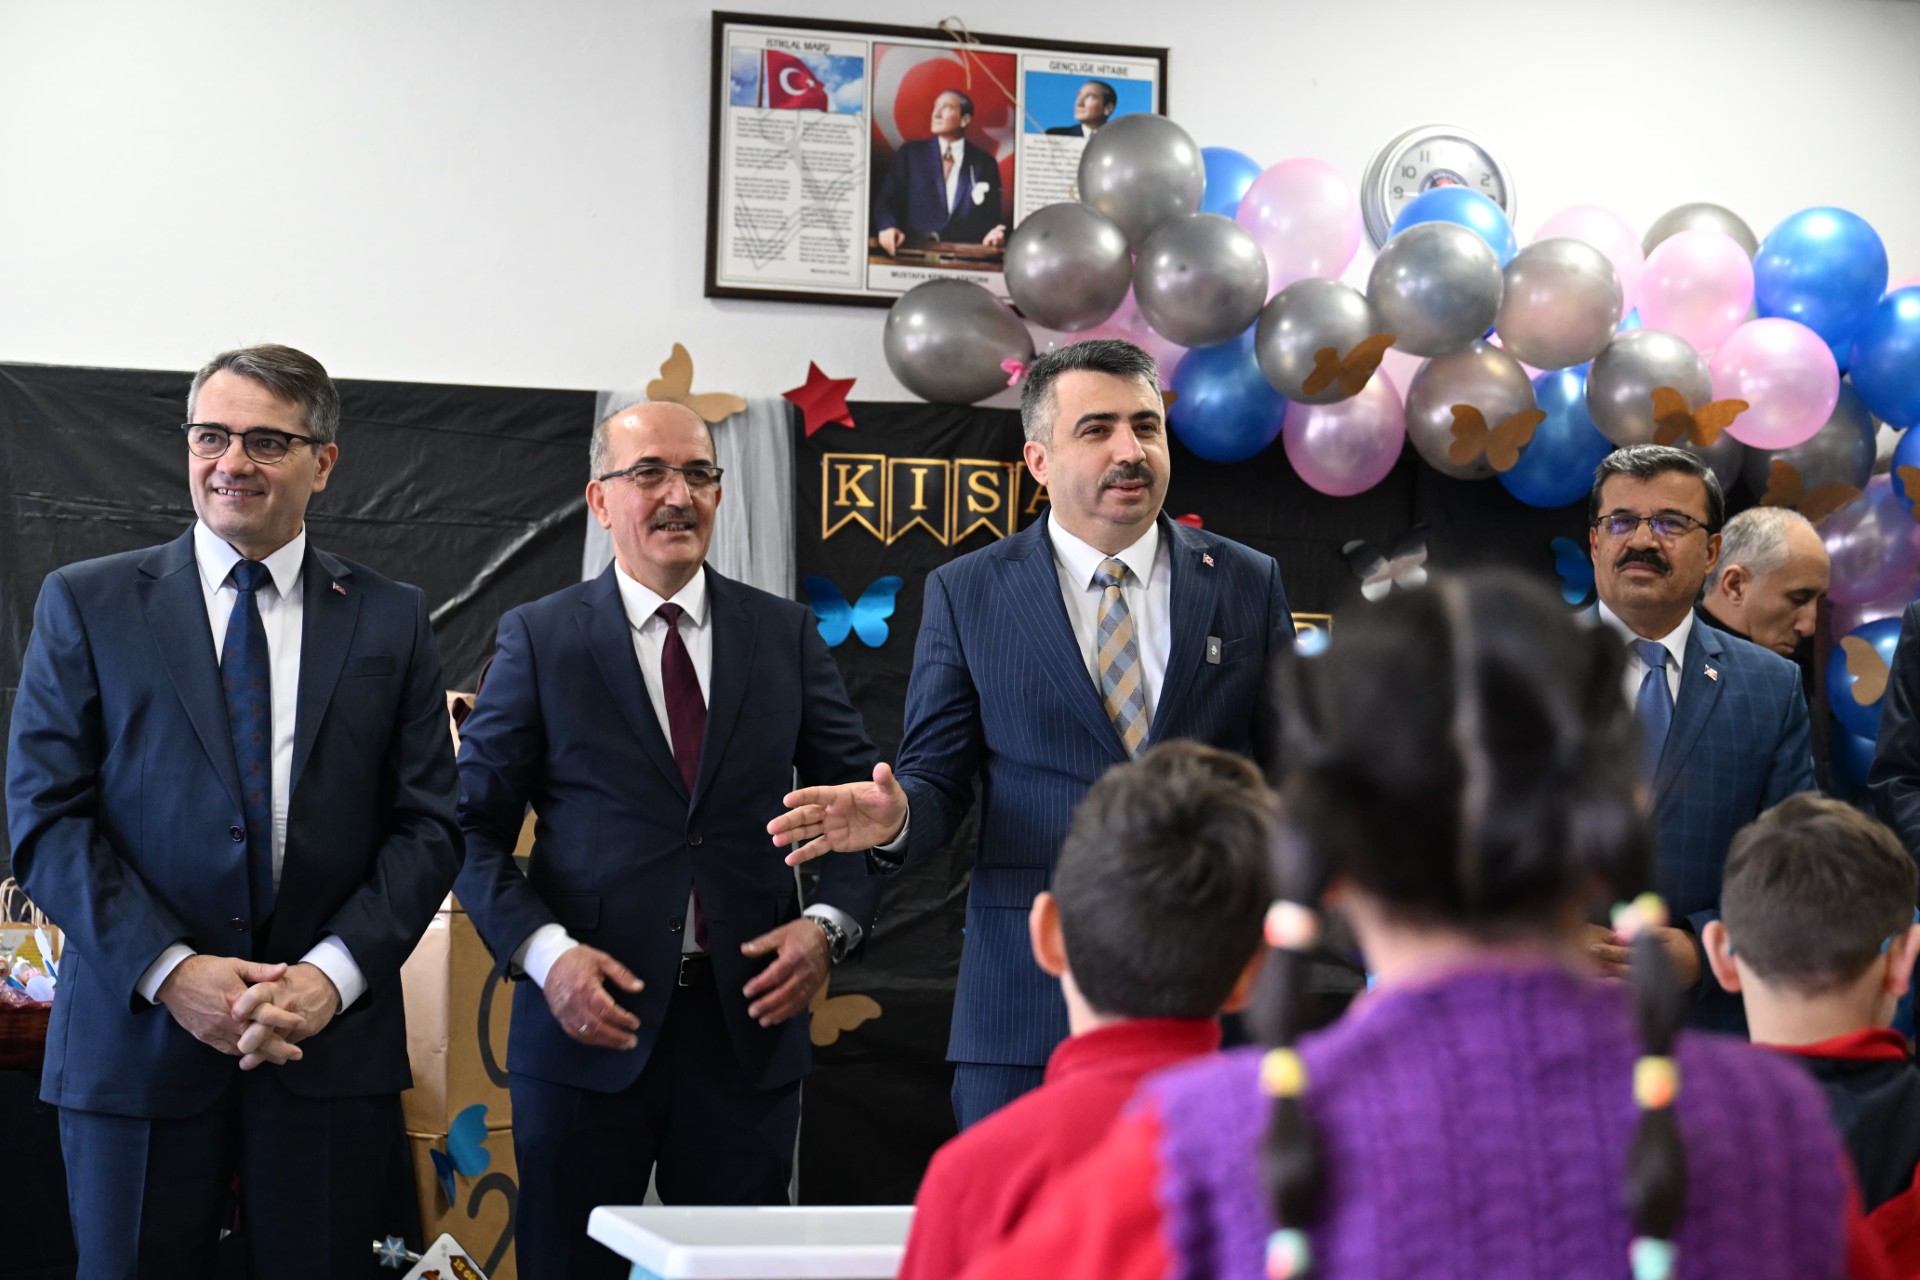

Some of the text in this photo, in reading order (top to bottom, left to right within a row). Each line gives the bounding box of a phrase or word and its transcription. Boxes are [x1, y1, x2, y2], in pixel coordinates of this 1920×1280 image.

[1401, 165, 1417, 179] 10
[1480, 173, 1490, 186] 2
[1394, 186, 1403, 198] 9
